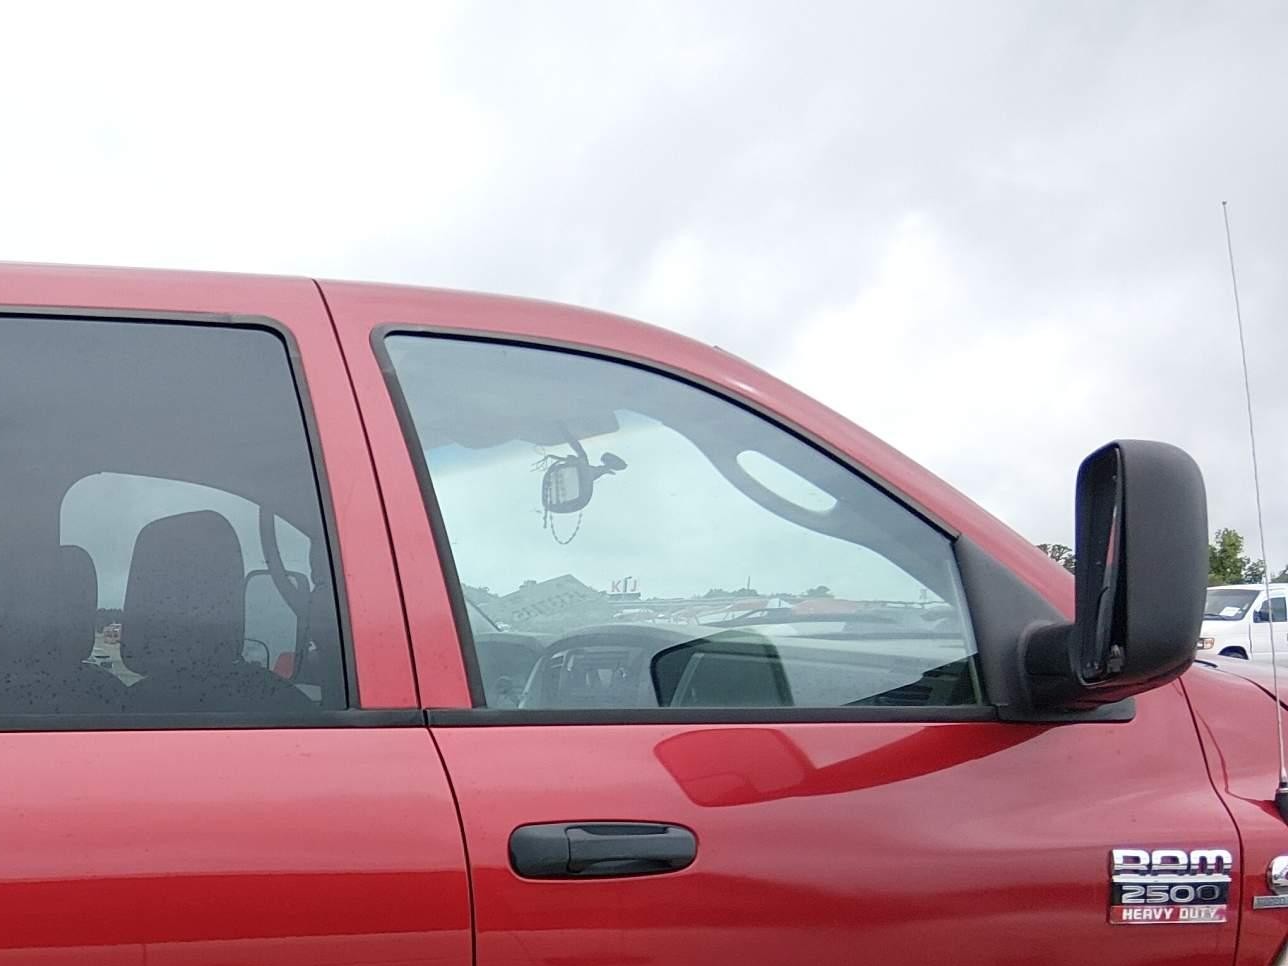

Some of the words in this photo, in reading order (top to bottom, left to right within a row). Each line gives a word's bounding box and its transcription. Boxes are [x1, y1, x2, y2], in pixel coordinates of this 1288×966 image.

[1121, 884, 1220, 904] 2500
[1122, 907, 1173, 921] HEAVY
[1179, 906, 1217, 920] DUTY
